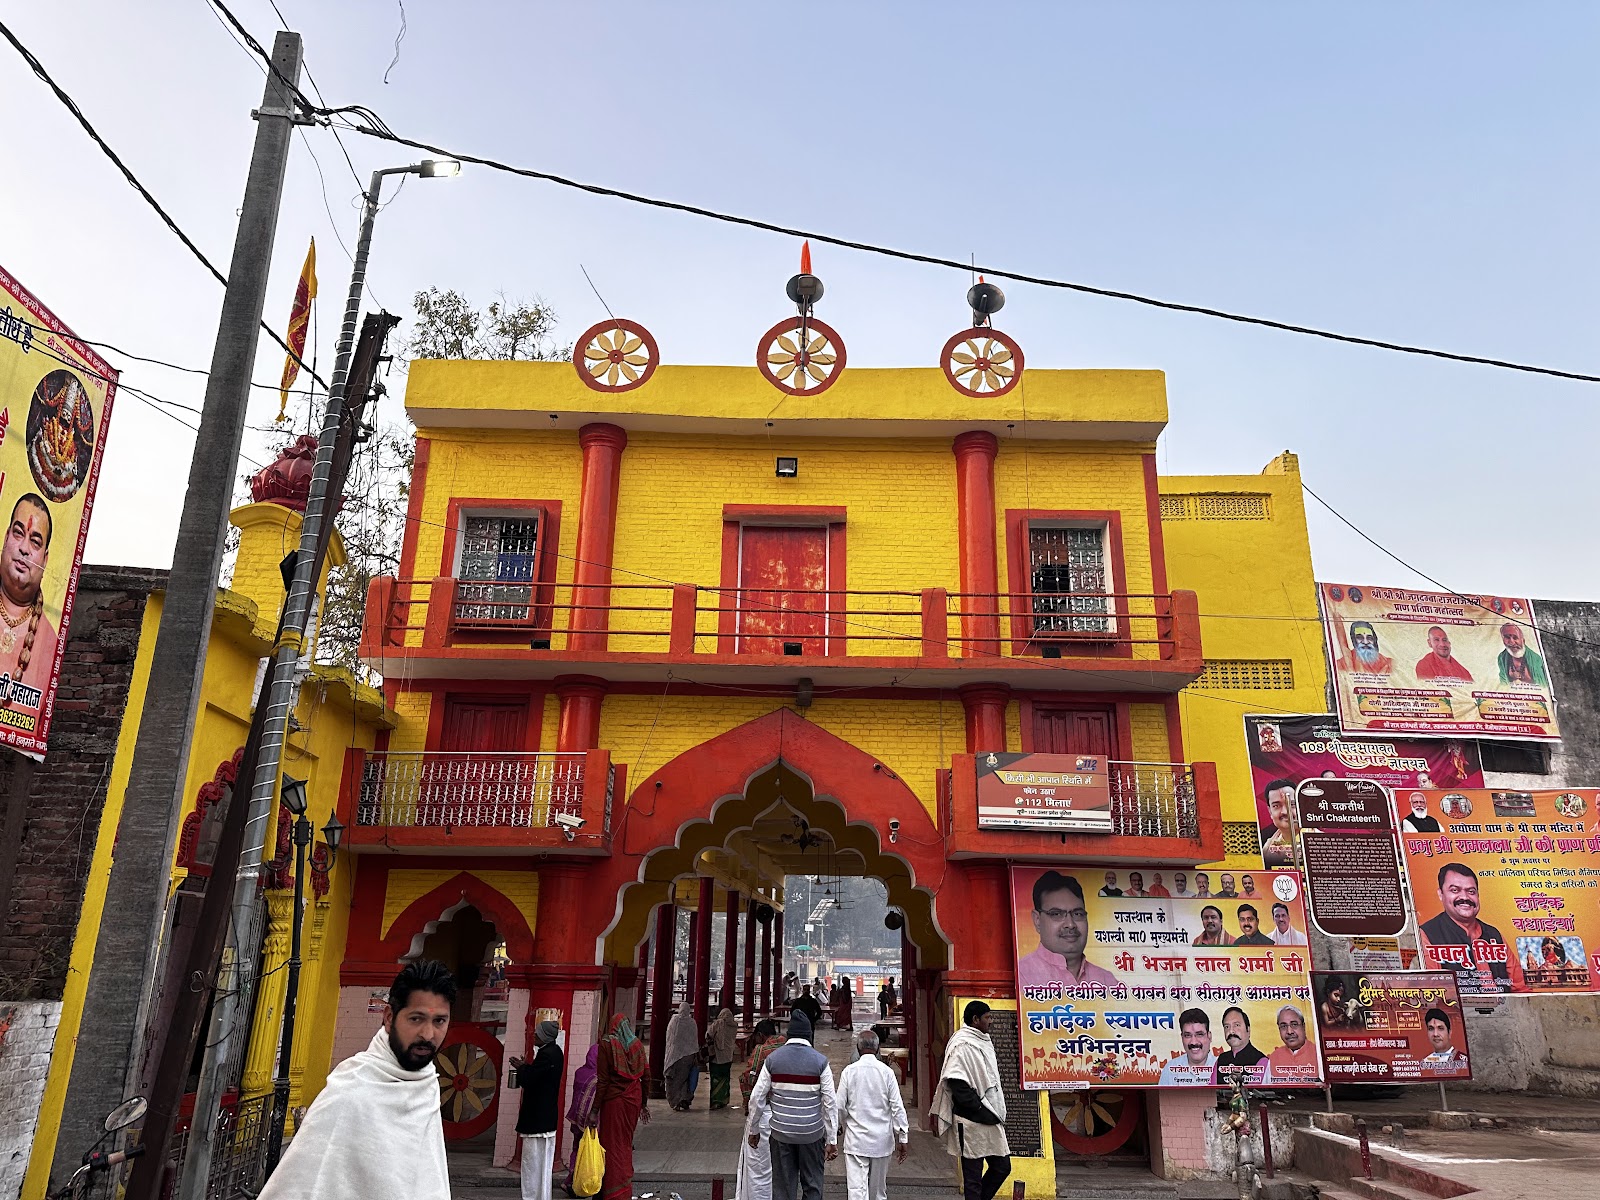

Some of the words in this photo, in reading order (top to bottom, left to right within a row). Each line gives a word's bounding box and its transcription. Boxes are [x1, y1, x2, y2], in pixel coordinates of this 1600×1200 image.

[1371, 589, 1381, 599] श्री
[1383, 590, 1393, 600] श्री
[1395, 590, 1405, 600] श्री
[1394, 603, 1409, 612] प्राण
[1411, 603, 1432, 614] प्रतिष्ठा
[1433, 606, 1464, 616] महोत्सव
[11, 681, 42, 710] महाराज
[7, 731, 16, 744] श्री
[1300, 743, 1324, 753] 108
[1084, 759, 1097, 768] 112
[1004, 772, 1024, 783] किसी
[1026, 773, 1035, 783] भी
[1037, 776, 1060, 784] आपात
[1085, 775, 1093, 785] में
[1022, 786, 1037, 795] फोन
[1025, 798, 1042, 807] 112
[1045, 797, 1073, 808] मिलाएं
[1318, 800, 1328, 811] श्री
[1331, 800, 1364, 811] चक्रतीर्थ
[1306, 813, 1324, 822] Shri
[1326, 813, 1381, 823] Chakrateerth
[1505, 822, 1514, 833] के
[1518, 823, 1529, 833] श्री
[1532, 824, 1547, 833] राम
[1549, 822, 1573, 833] मन्दिर
[1576, 822, 1585, 833] में
[1407, 839, 1432, 856] प्रभु
[1434, 836, 1452, 853] श्री
[1455, 839, 1511, 853] रामलला
[1515, 835, 1533, 853] जी
[1556, 838, 1585, 854] प्राण
[1114, 911, 1152, 923] राजस्थान
[1156, 908, 1165, 923] के
[1095, 928, 1125, 943] यशस्वी
[1150, 928, 1188, 948] मुख्यमंत्री
[1426, 945, 1474, 968] बबलू
[1473, 939, 1507, 961] सिंह
[1114, 952, 1135, 972] श्री
[1142, 956, 1187, 972] भजन
[1195, 957, 1231, 972] लाल
[1239, 951, 1274, 972] शर्मा
[1281, 953, 1303, 972] जी
[1065, 982, 1106, 1000] दधीचि
[1110, 983, 1127, 1000] की
[1131, 987, 1166, 1000] पावन
[1170, 986, 1191, 1000] धरा
[1196, 982, 1241, 1004] सीतापुर
[1246, 987, 1291, 1000] आगमन
[1294, 987, 1311, 1000] पर
[1389, 989, 1421, 1008] भागवत
[1421, 988, 1456, 1006] कथा
[1028, 1005, 1095, 1033] हार्दिक
[1104, 1012, 1175, 1030] स्वागत
[1056, 1034, 1151, 1057] अभिनंदन
[1170, 1065, 1189, 1073] राजेश
